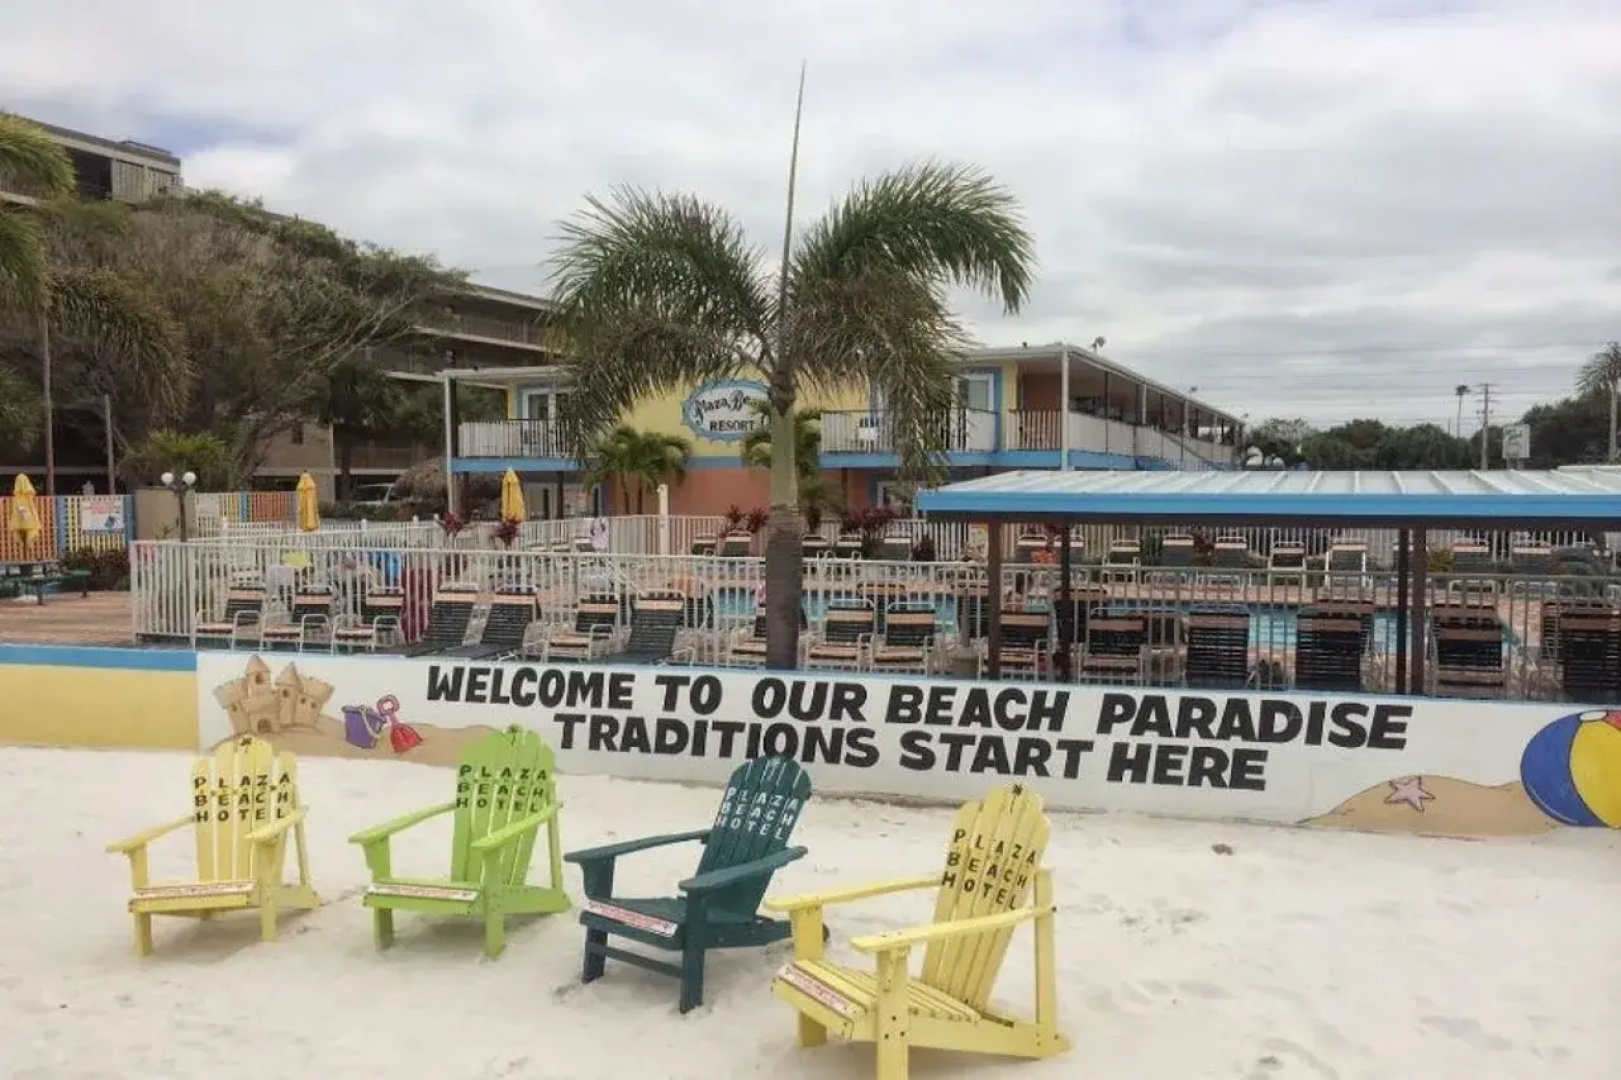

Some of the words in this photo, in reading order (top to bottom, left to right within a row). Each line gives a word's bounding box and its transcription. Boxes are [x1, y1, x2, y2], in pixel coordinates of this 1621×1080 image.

[709, 420, 755, 431] RESORT
[427, 665, 635, 709] WELCOME
[655, 674, 723, 715] TO
[751, 677, 867, 722] OUR
[884, 684, 1071, 731] BEACH
[1097, 694, 1414, 750] PARADISE
[553, 713, 879, 768] TRADITIONS
[899, 730, 1094, 779] START
[1106, 742, 1269, 791] HERE
[194, 772, 290, 790] PLAZA
[458, 765, 547, 783] PLAZA
[194, 791, 289, 806] BEACH
[457, 781, 544, 797] BEACH
[727, 787, 798, 810] PLAZA
[196, 808, 286, 822] HOTEL
[456, 797, 538, 813] HOTEL
[721, 802, 794, 825] BEACH
[716, 814, 784, 840] HOTEL
[954, 828, 1035, 864] PLAZA
[948, 851, 1027, 886] BEACH
[942, 871, 1018, 909] HOTEL
